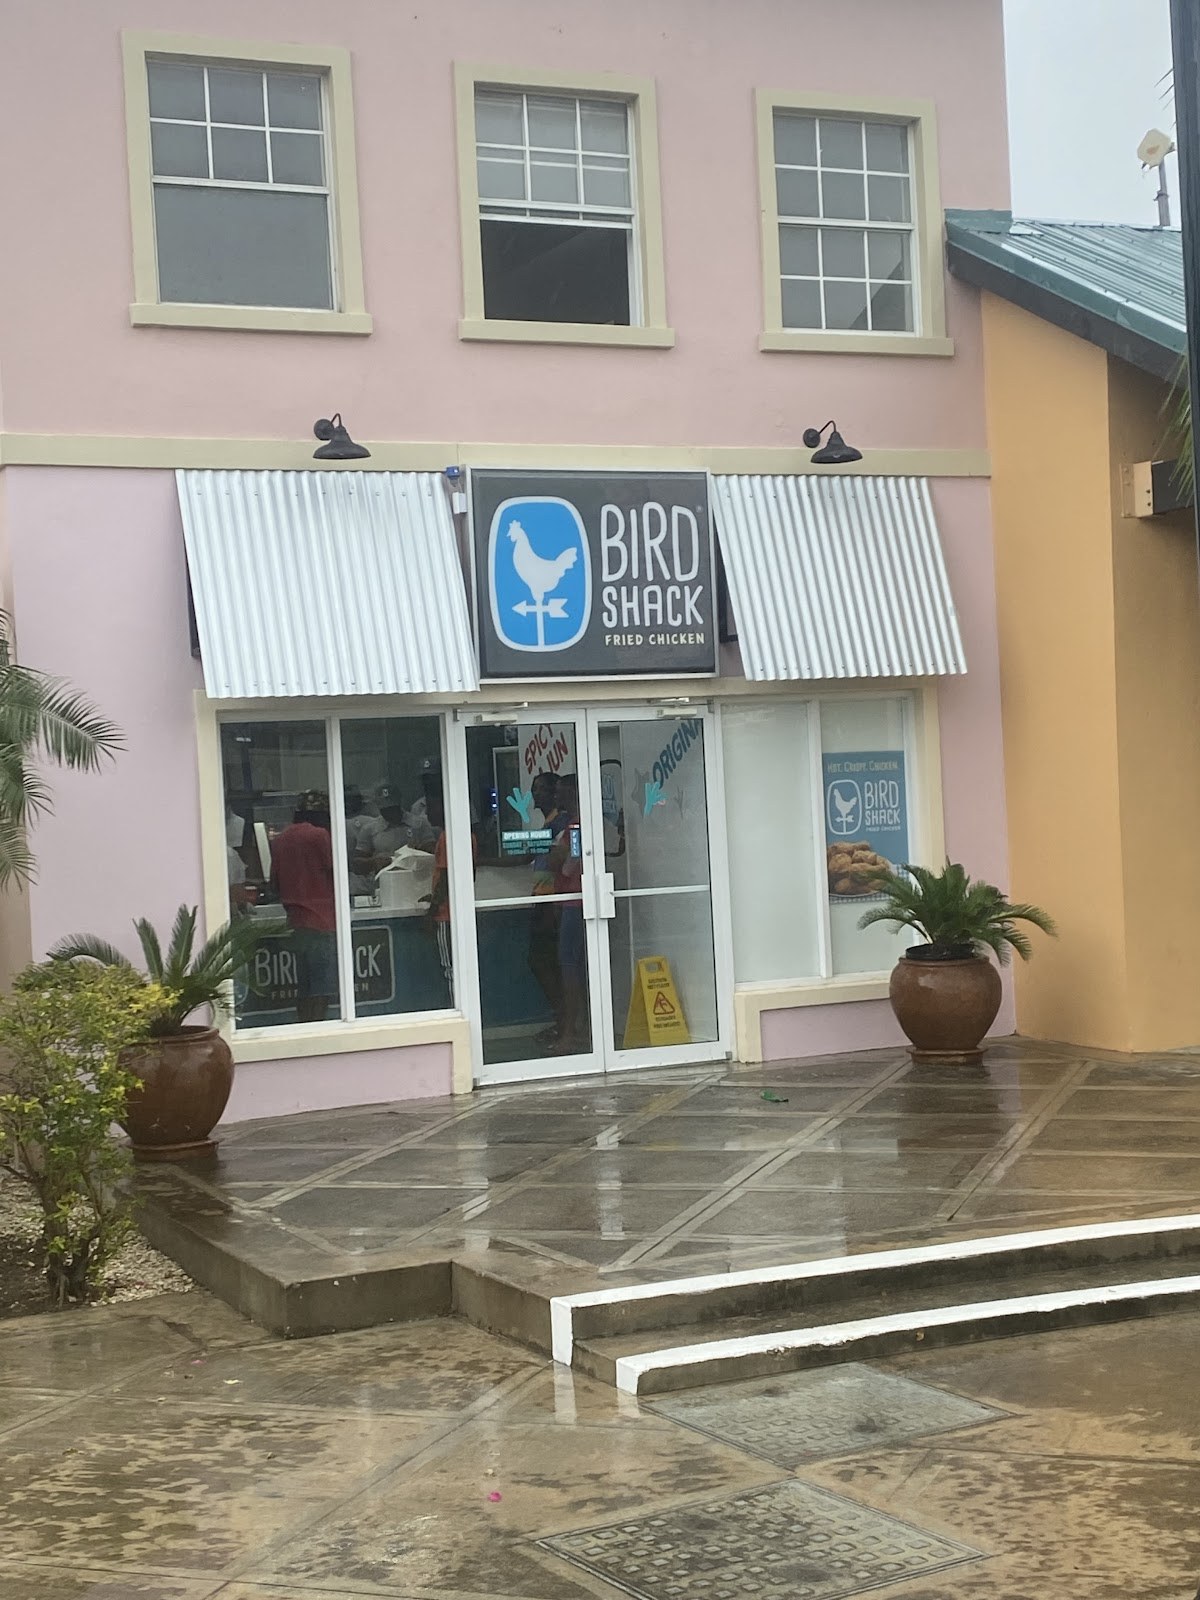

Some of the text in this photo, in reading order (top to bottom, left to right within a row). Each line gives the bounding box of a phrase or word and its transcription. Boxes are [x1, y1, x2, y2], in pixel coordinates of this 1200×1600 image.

[600, 501, 699, 582] BIRD
[602, 585, 704, 628] SHACK
[605, 632, 705, 646] FRIED CHICKEN
[864, 779, 899, 809] BIRD
[864, 808, 900, 826] SHACK
[255, 948, 298, 987] BIR
